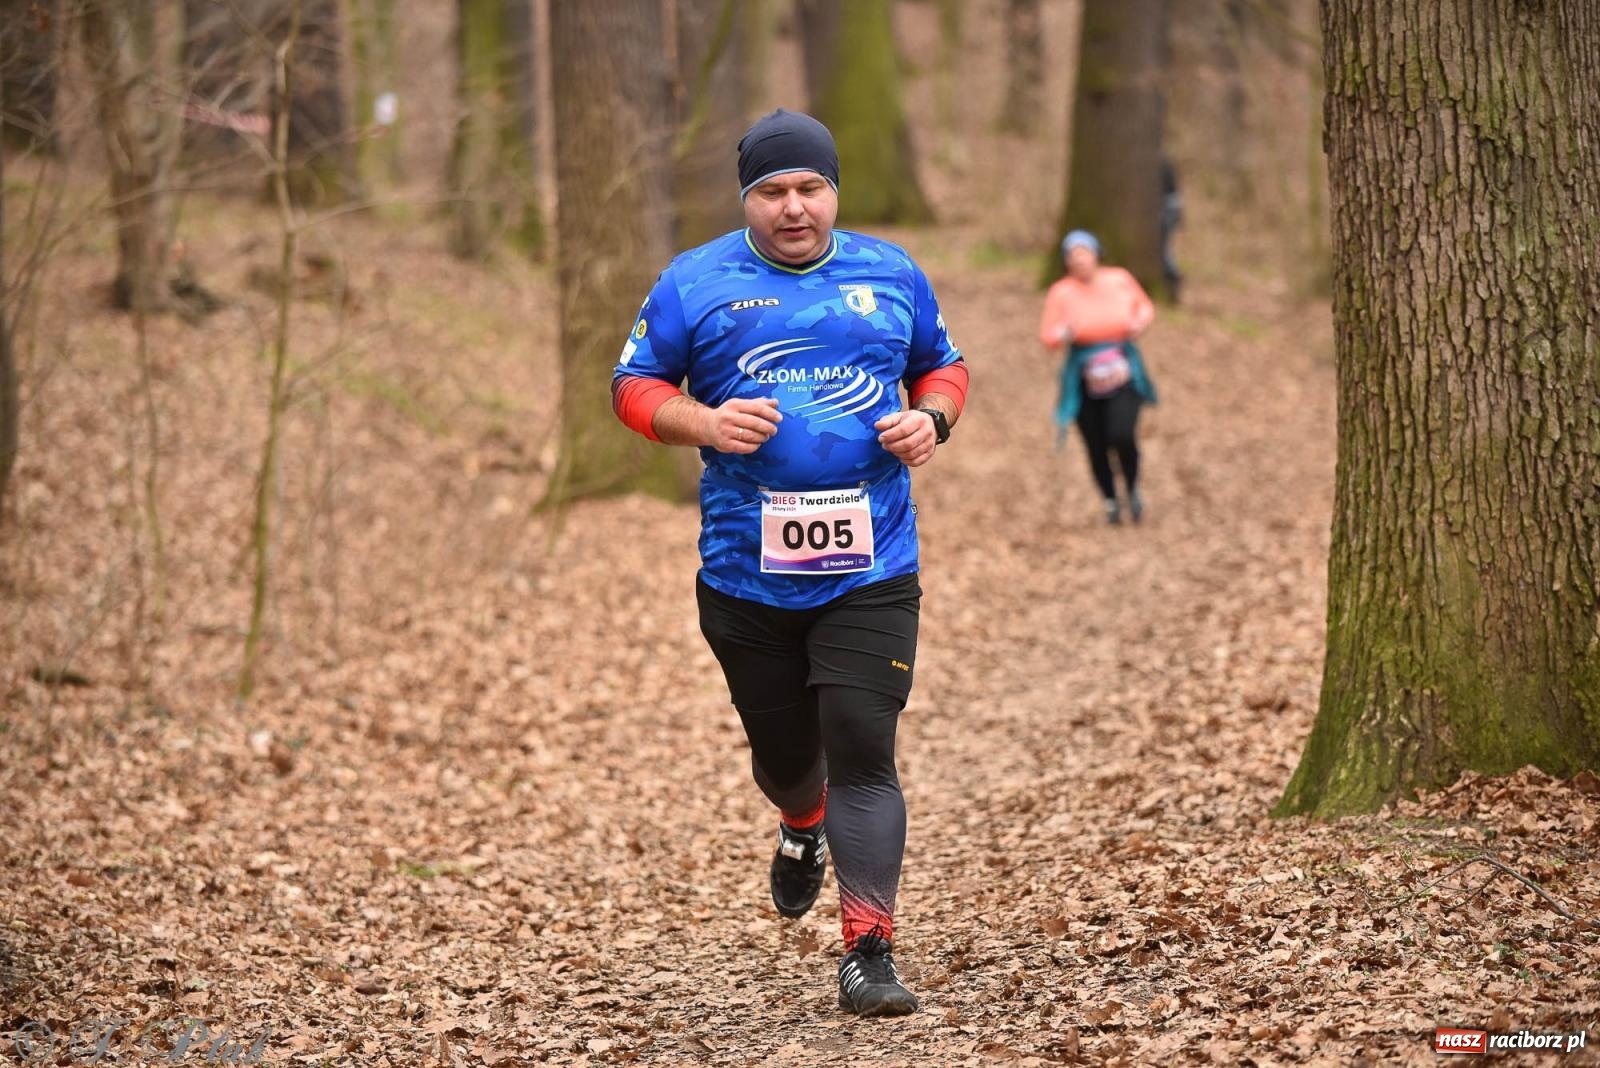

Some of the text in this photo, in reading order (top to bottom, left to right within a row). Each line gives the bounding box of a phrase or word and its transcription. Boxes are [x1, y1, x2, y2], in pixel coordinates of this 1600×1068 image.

[730, 298, 780, 311] zina
[756, 365, 854, 384] ZŁOM-MAX
[787, 382, 844, 393] Firma Handlowa
[772, 494, 860, 506] BIEG Twardziela
[782, 519, 854, 550] 005
